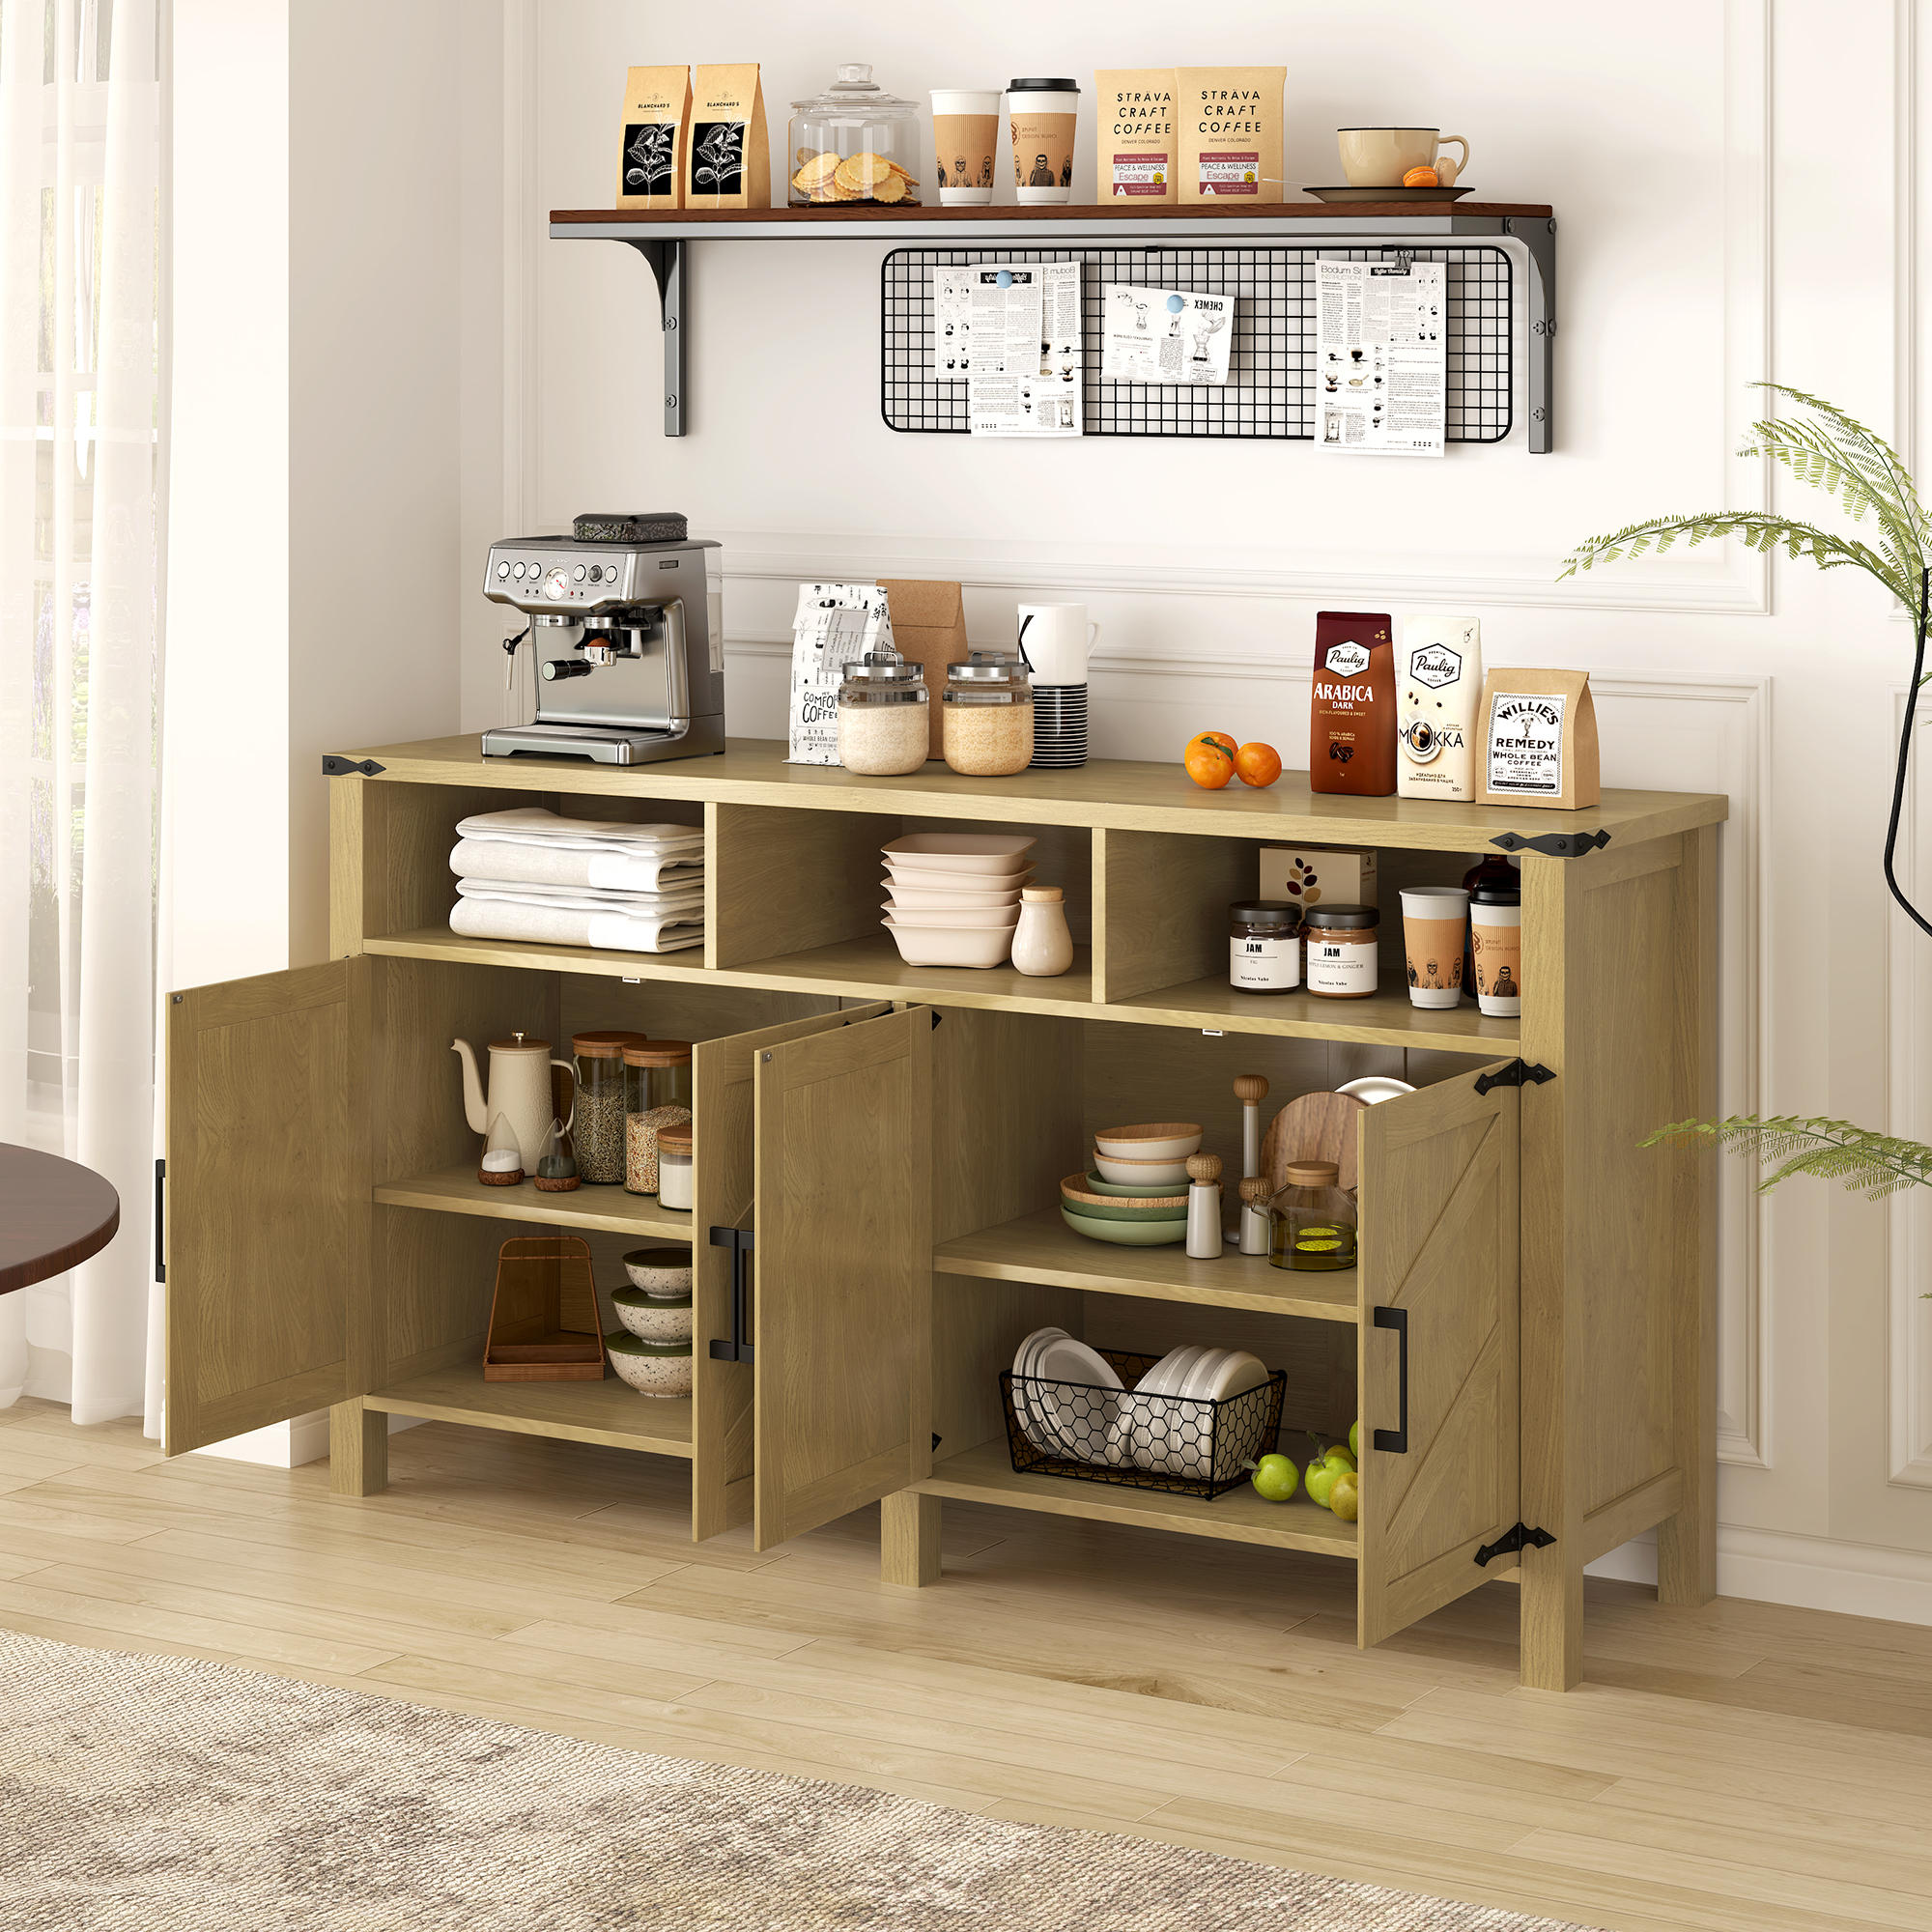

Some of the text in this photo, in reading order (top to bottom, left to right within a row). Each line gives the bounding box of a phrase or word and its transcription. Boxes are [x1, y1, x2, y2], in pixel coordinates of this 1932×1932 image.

[1117, 91, 1171, 102] STRÄVA
[1201, 89, 1261, 100] STRÄVA
[1119, 106, 1167, 118] CRAFT
[1205, 105, 1256, 116] CRAFT
[1114, 123, 1171, 134] COFFEE
[1199, 122, 1262, 133] COFFEE
[1119, 172, 1149, 182] Escape
[1207, 170, 1240, 181] Escape
[1321, 265, 1350, 273] Bodum
[1329, 650, 1365, 668] Paulig
[1415, 655, 1456, 677] Paulig
[1314, 683, 1374, 702] ARABICA
[804, 692, 838, 709] COMFOR
[1496, 701, 1559, 725] WILLIE'S
[1399, 722, 1464, 752] MOKKA
[1496, 738, 1554, 750] REMEDY
[1492, 751, 1526, 759] WHOLE
[1246, 944, 1262, 952] JAM
[1323, 948, 1340, 957] JAM
